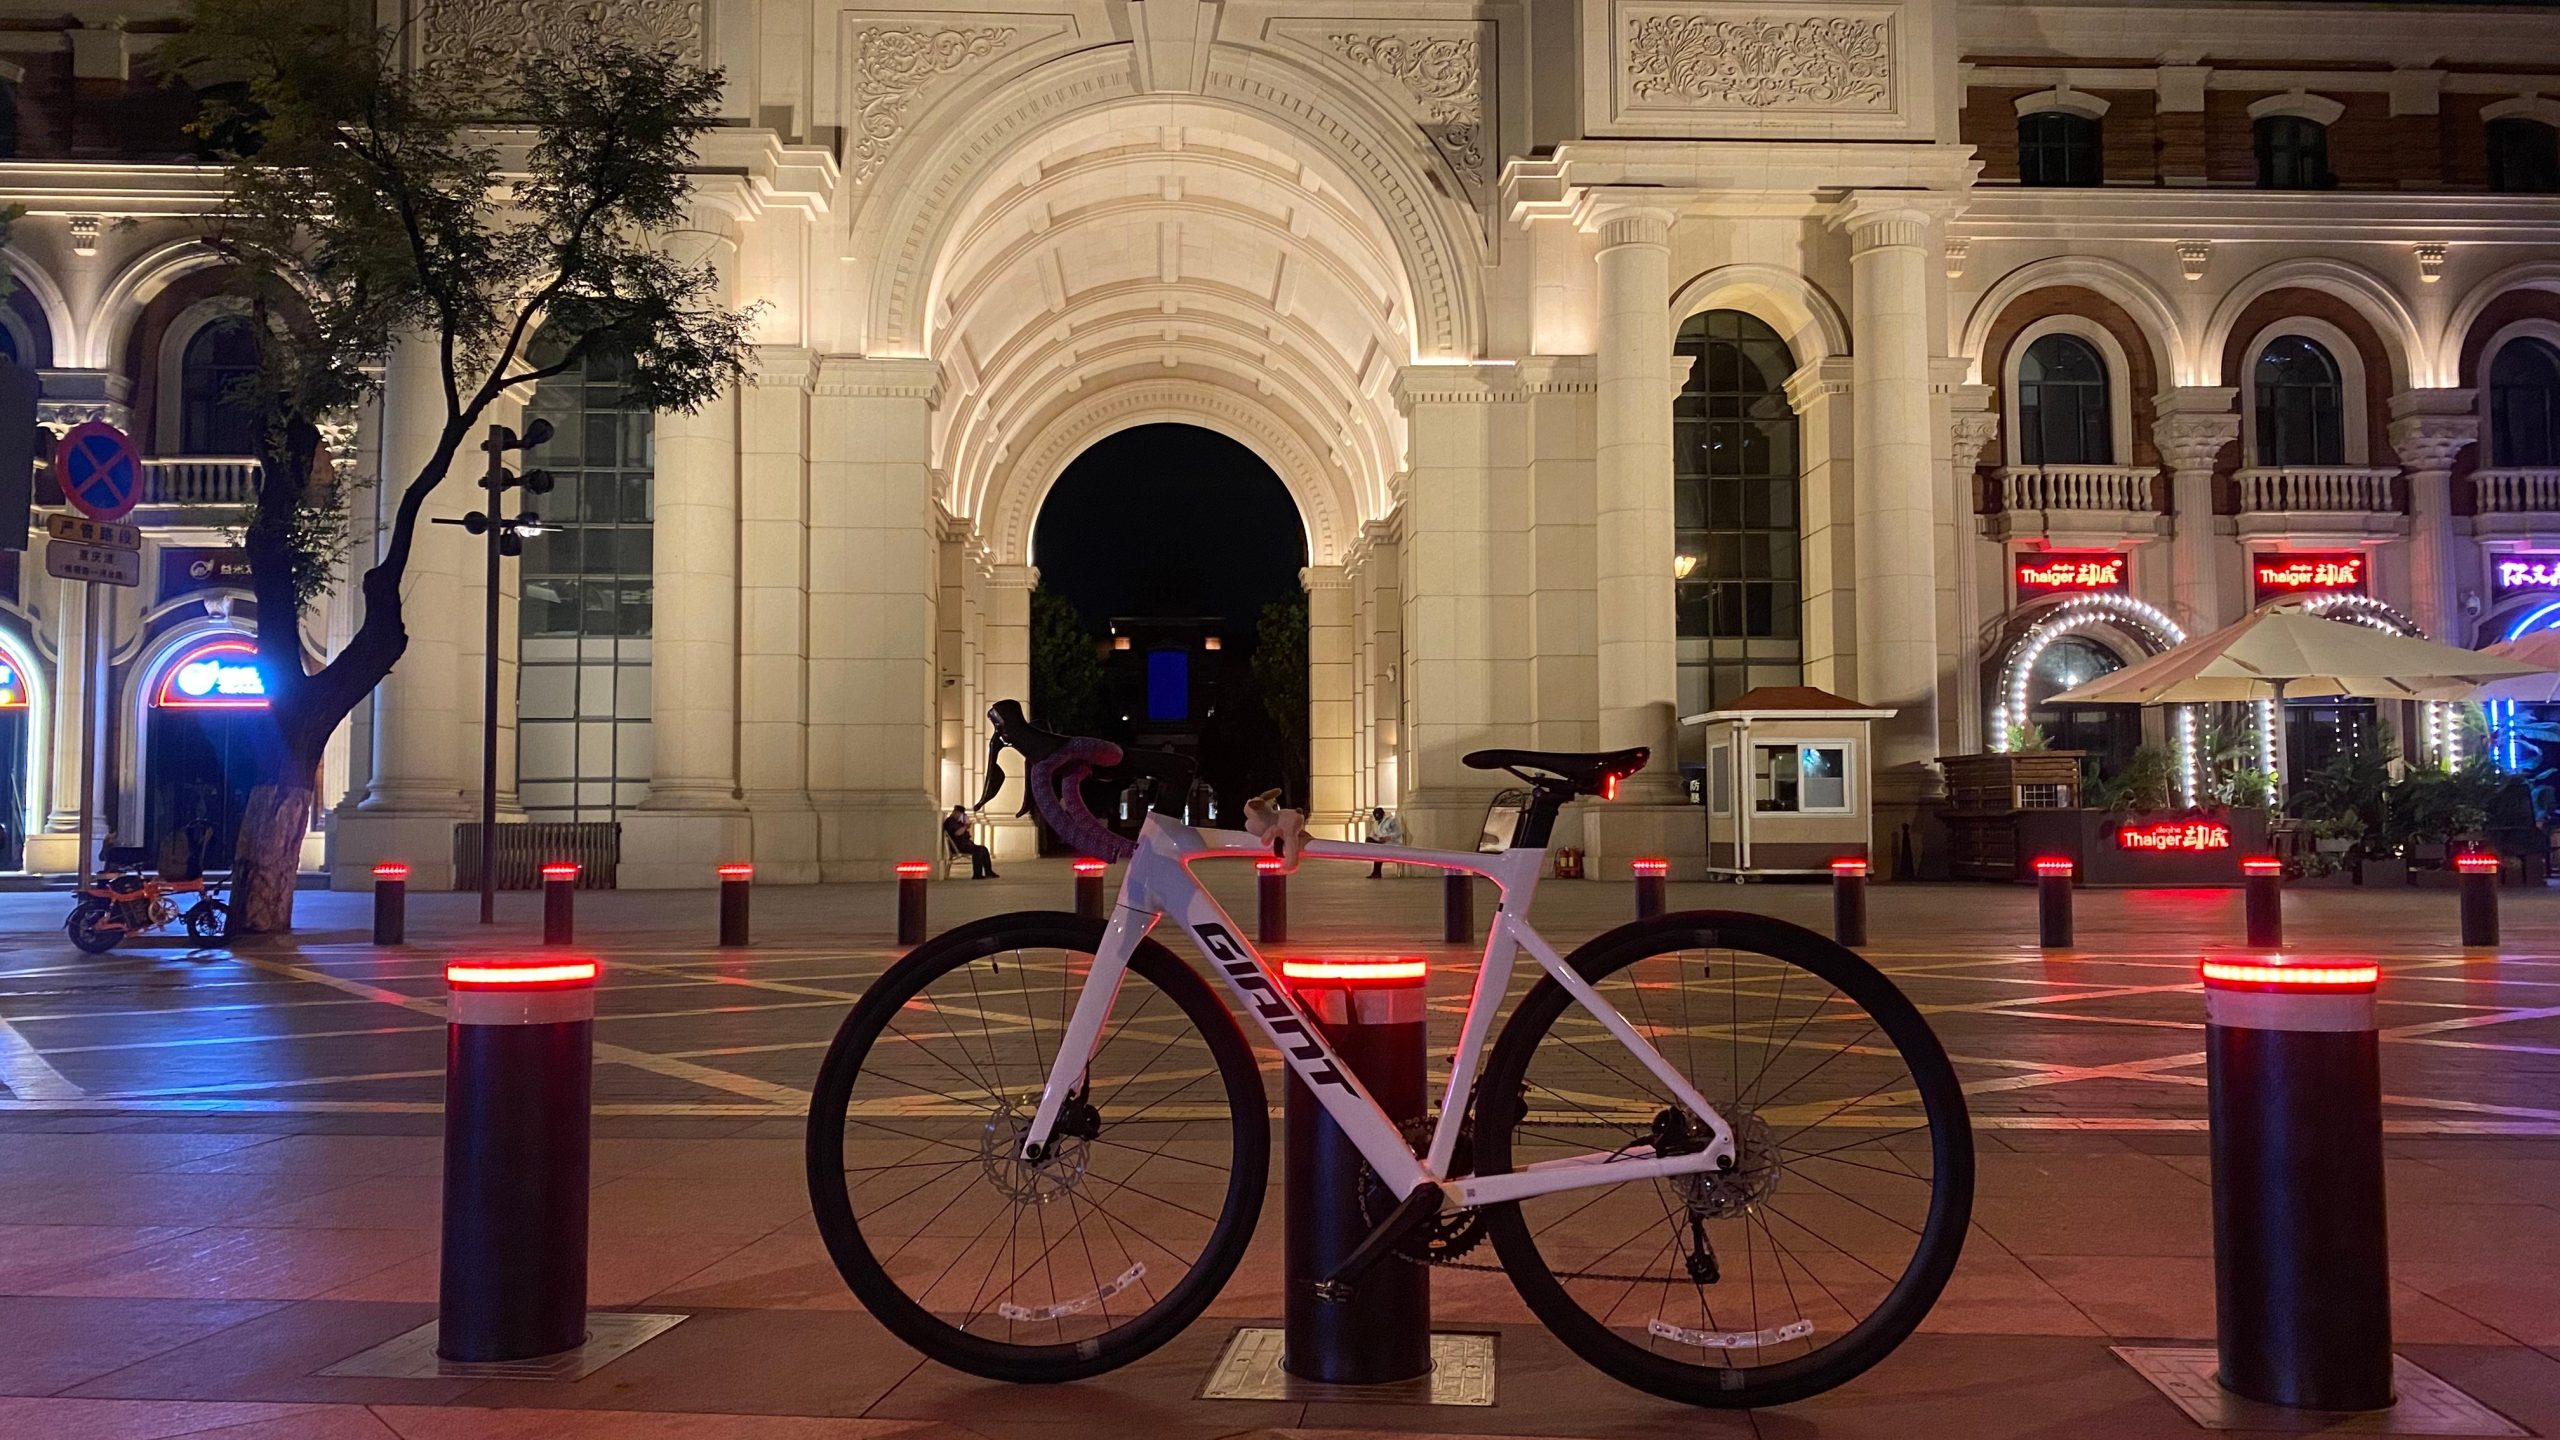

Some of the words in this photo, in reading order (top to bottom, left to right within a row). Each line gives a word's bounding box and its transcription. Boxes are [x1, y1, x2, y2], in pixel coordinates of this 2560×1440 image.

[2021, 569, 2075, 586] Thaiger
[2260, 569, 2313, 586] Thaiger
[2124, 832, 2182, 850] Thaiger
[1192, 923, 1361, 1099] GIANT
